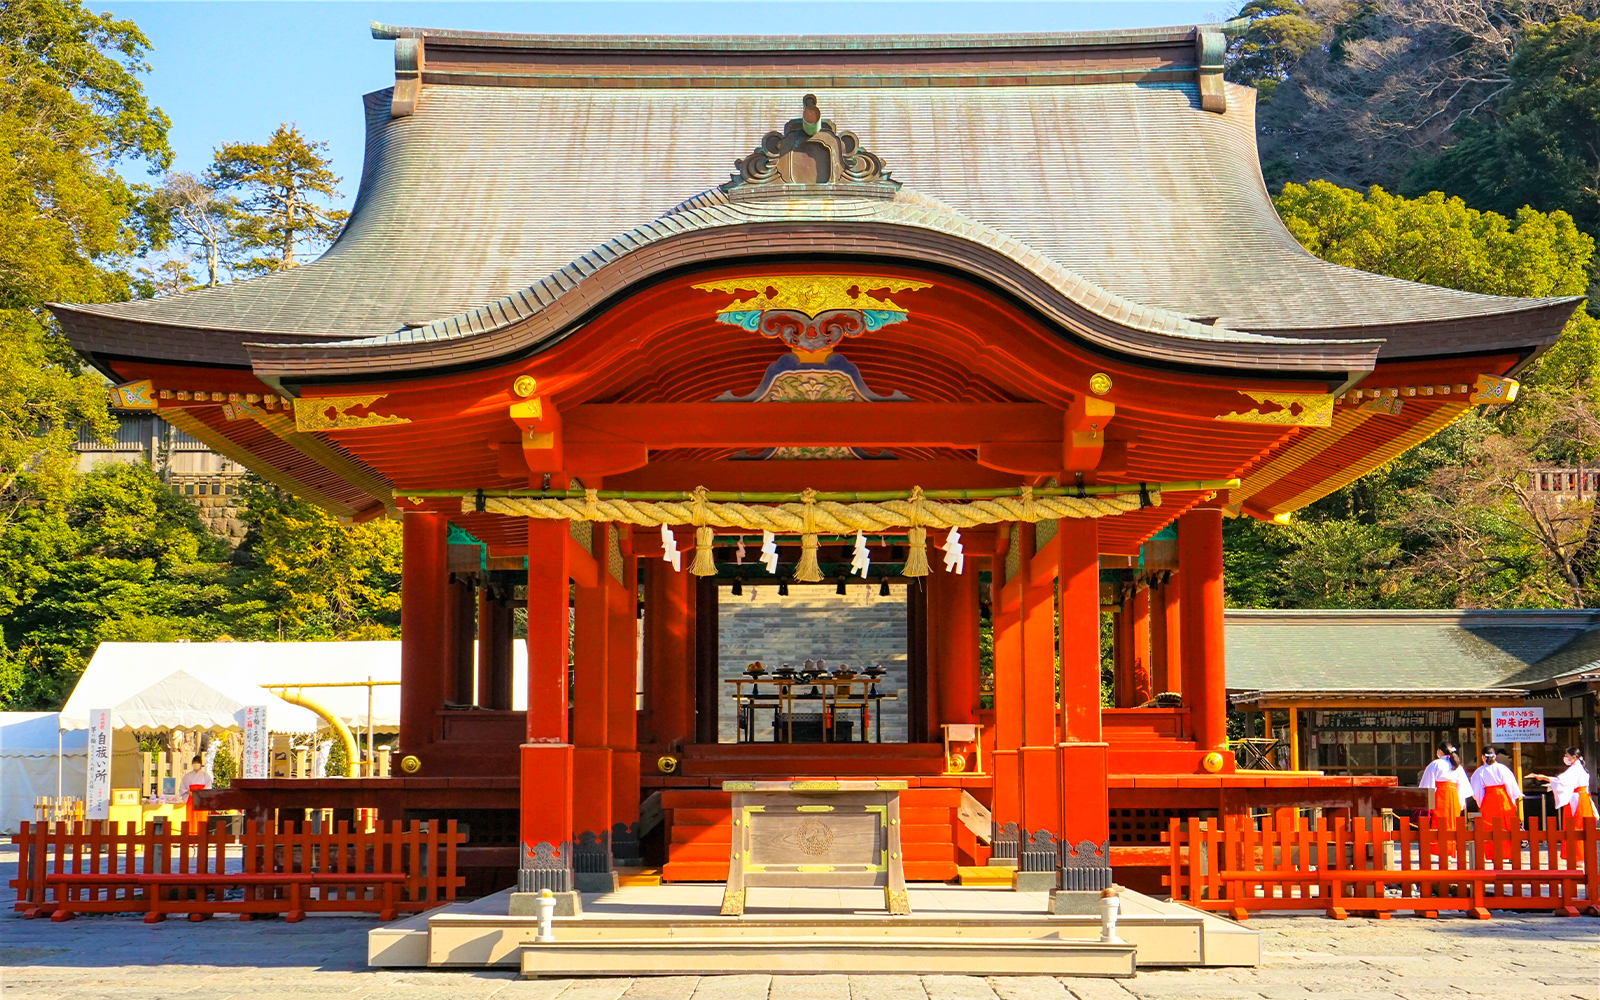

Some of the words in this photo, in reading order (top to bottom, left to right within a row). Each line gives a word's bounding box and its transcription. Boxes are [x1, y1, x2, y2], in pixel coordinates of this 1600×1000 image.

[1496, 717, 1541, 729] 御朱印所
[94, 732, 108, 784] 自祓い所
